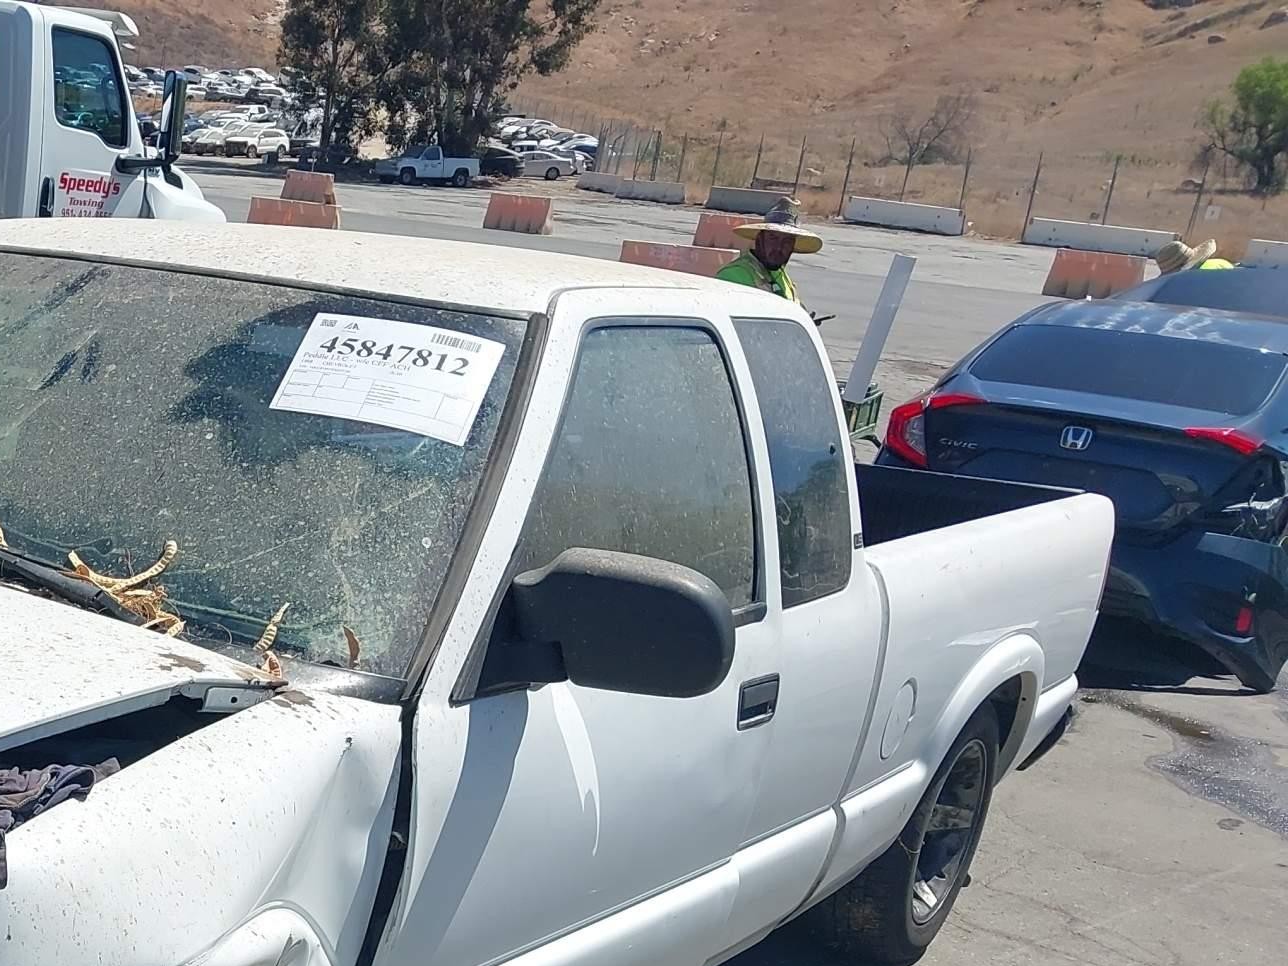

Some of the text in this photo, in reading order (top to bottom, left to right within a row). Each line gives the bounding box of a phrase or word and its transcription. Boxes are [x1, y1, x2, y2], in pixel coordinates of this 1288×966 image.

[58, 172, 120, 198] Speedy's
[69, 197, 105, 209] Towing
[319, 336, 469, 376] 45847812
[939, 437, 978, 450] CIVIC
